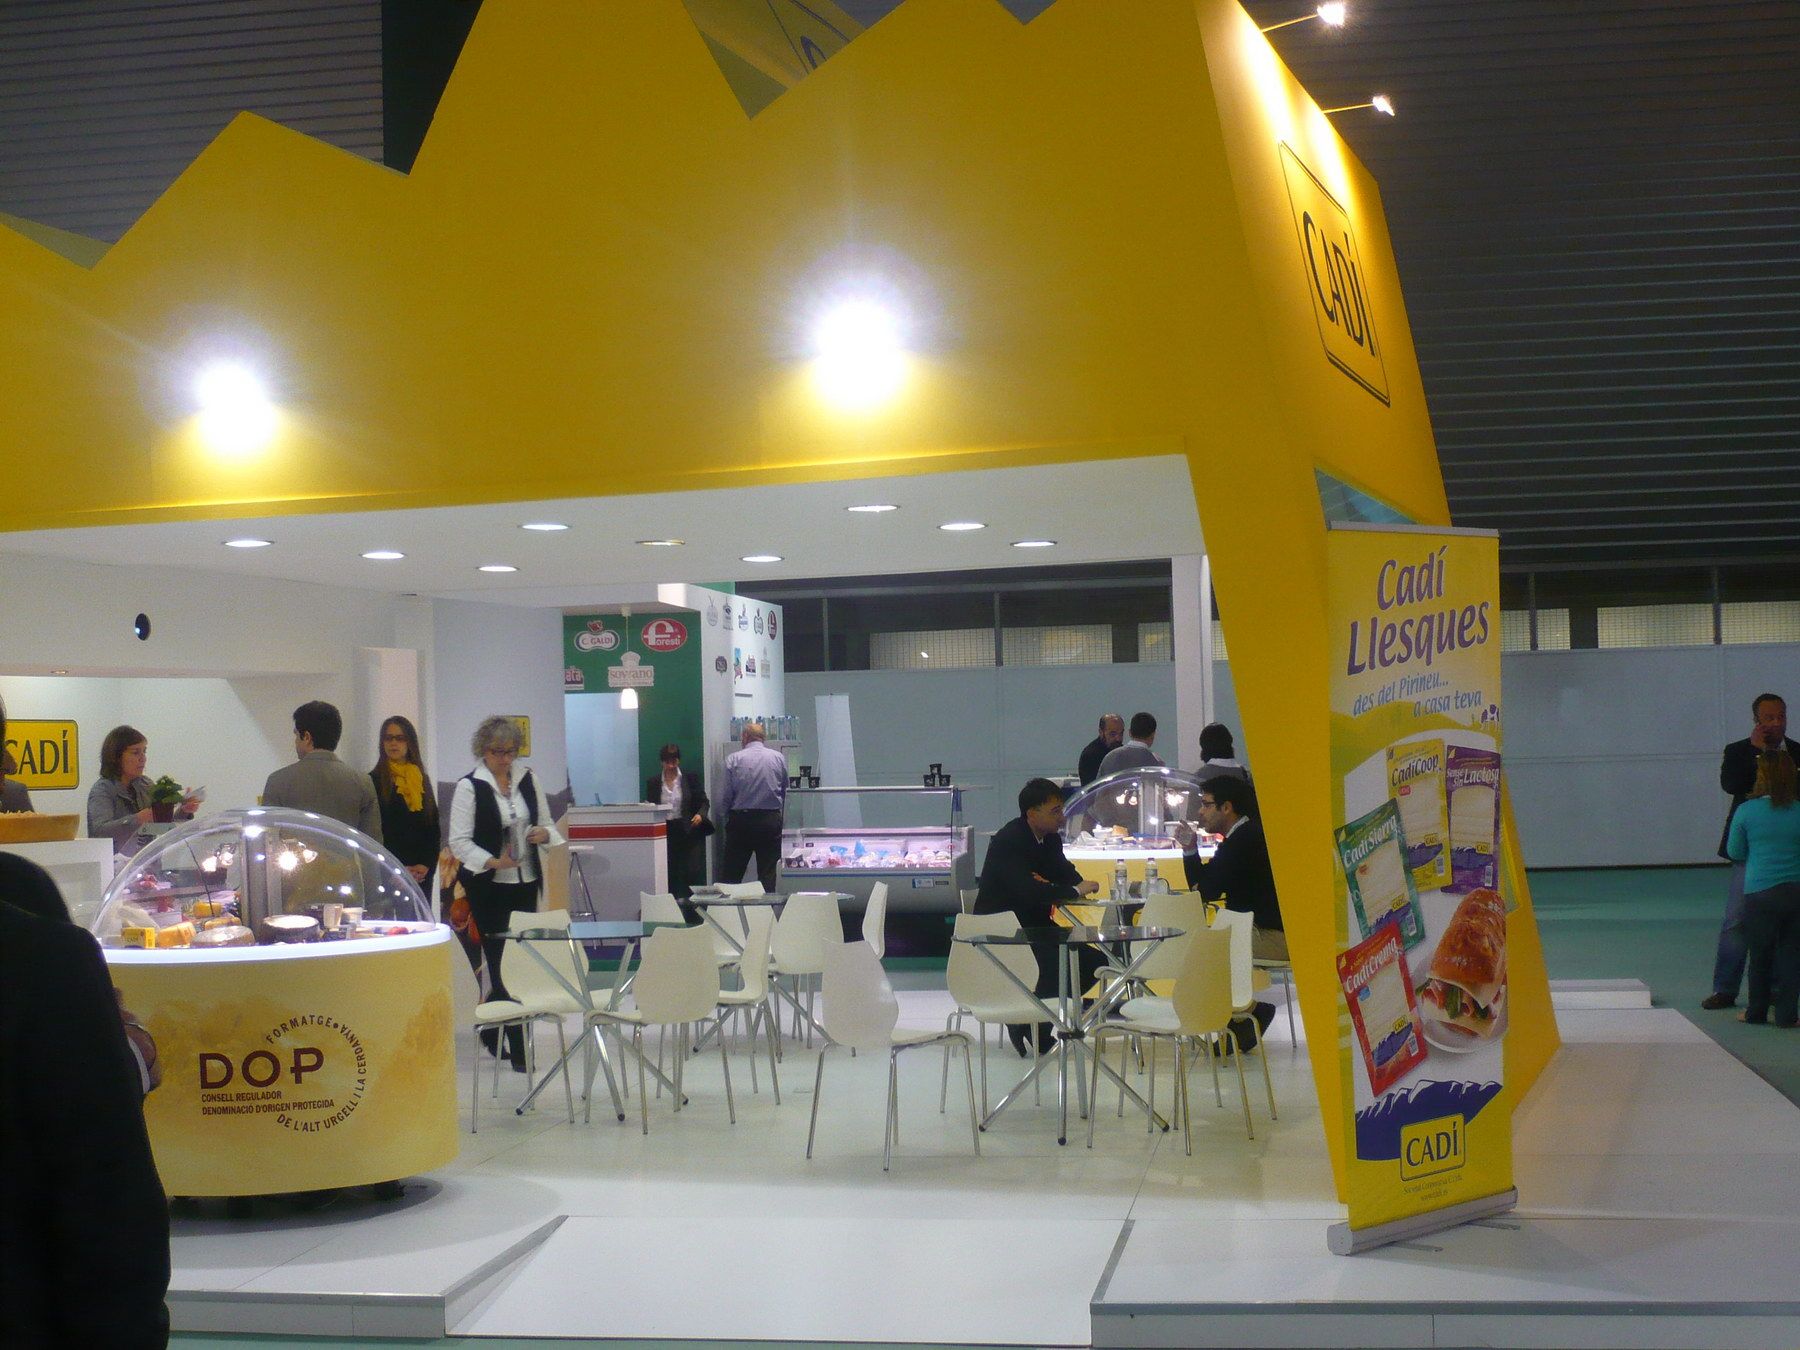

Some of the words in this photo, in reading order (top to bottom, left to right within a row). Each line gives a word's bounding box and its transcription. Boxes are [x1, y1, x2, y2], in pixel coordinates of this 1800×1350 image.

[1377, 545, 1448, 611] Cadí
[1347, 601, 1490, 676] Llesques
[1353, 694, 1374, 716] des
[1377, 682, 1396, 704] del
[1413, 700, 1421, 717] a
[1424, 696, 1451, 715] casa
[1454, 690, 1482, 710] teva
[266, 1014, 333, 1044] FORMATGE
[340, 1023, 367, 1075] CERDANYA
[199, 1047, 324, 1089] DOP
[201, 1092, 235, 1102] CONSELL
[236, 1091, 282, 1101] REGULADOR
[356, 1078, 366, 1092] LA
[255, 1102, 291, 1113] D'ORIGEN
[292, 1099, 335, 1111] PROTEGIDA
[324, 1100, 359, 1129] URGELL
[277, 1114, 291, 1128] DE
[294, 1121, 321, 1132] L'ALT
[1406, 1121, 1458, 1167] CADÍ
